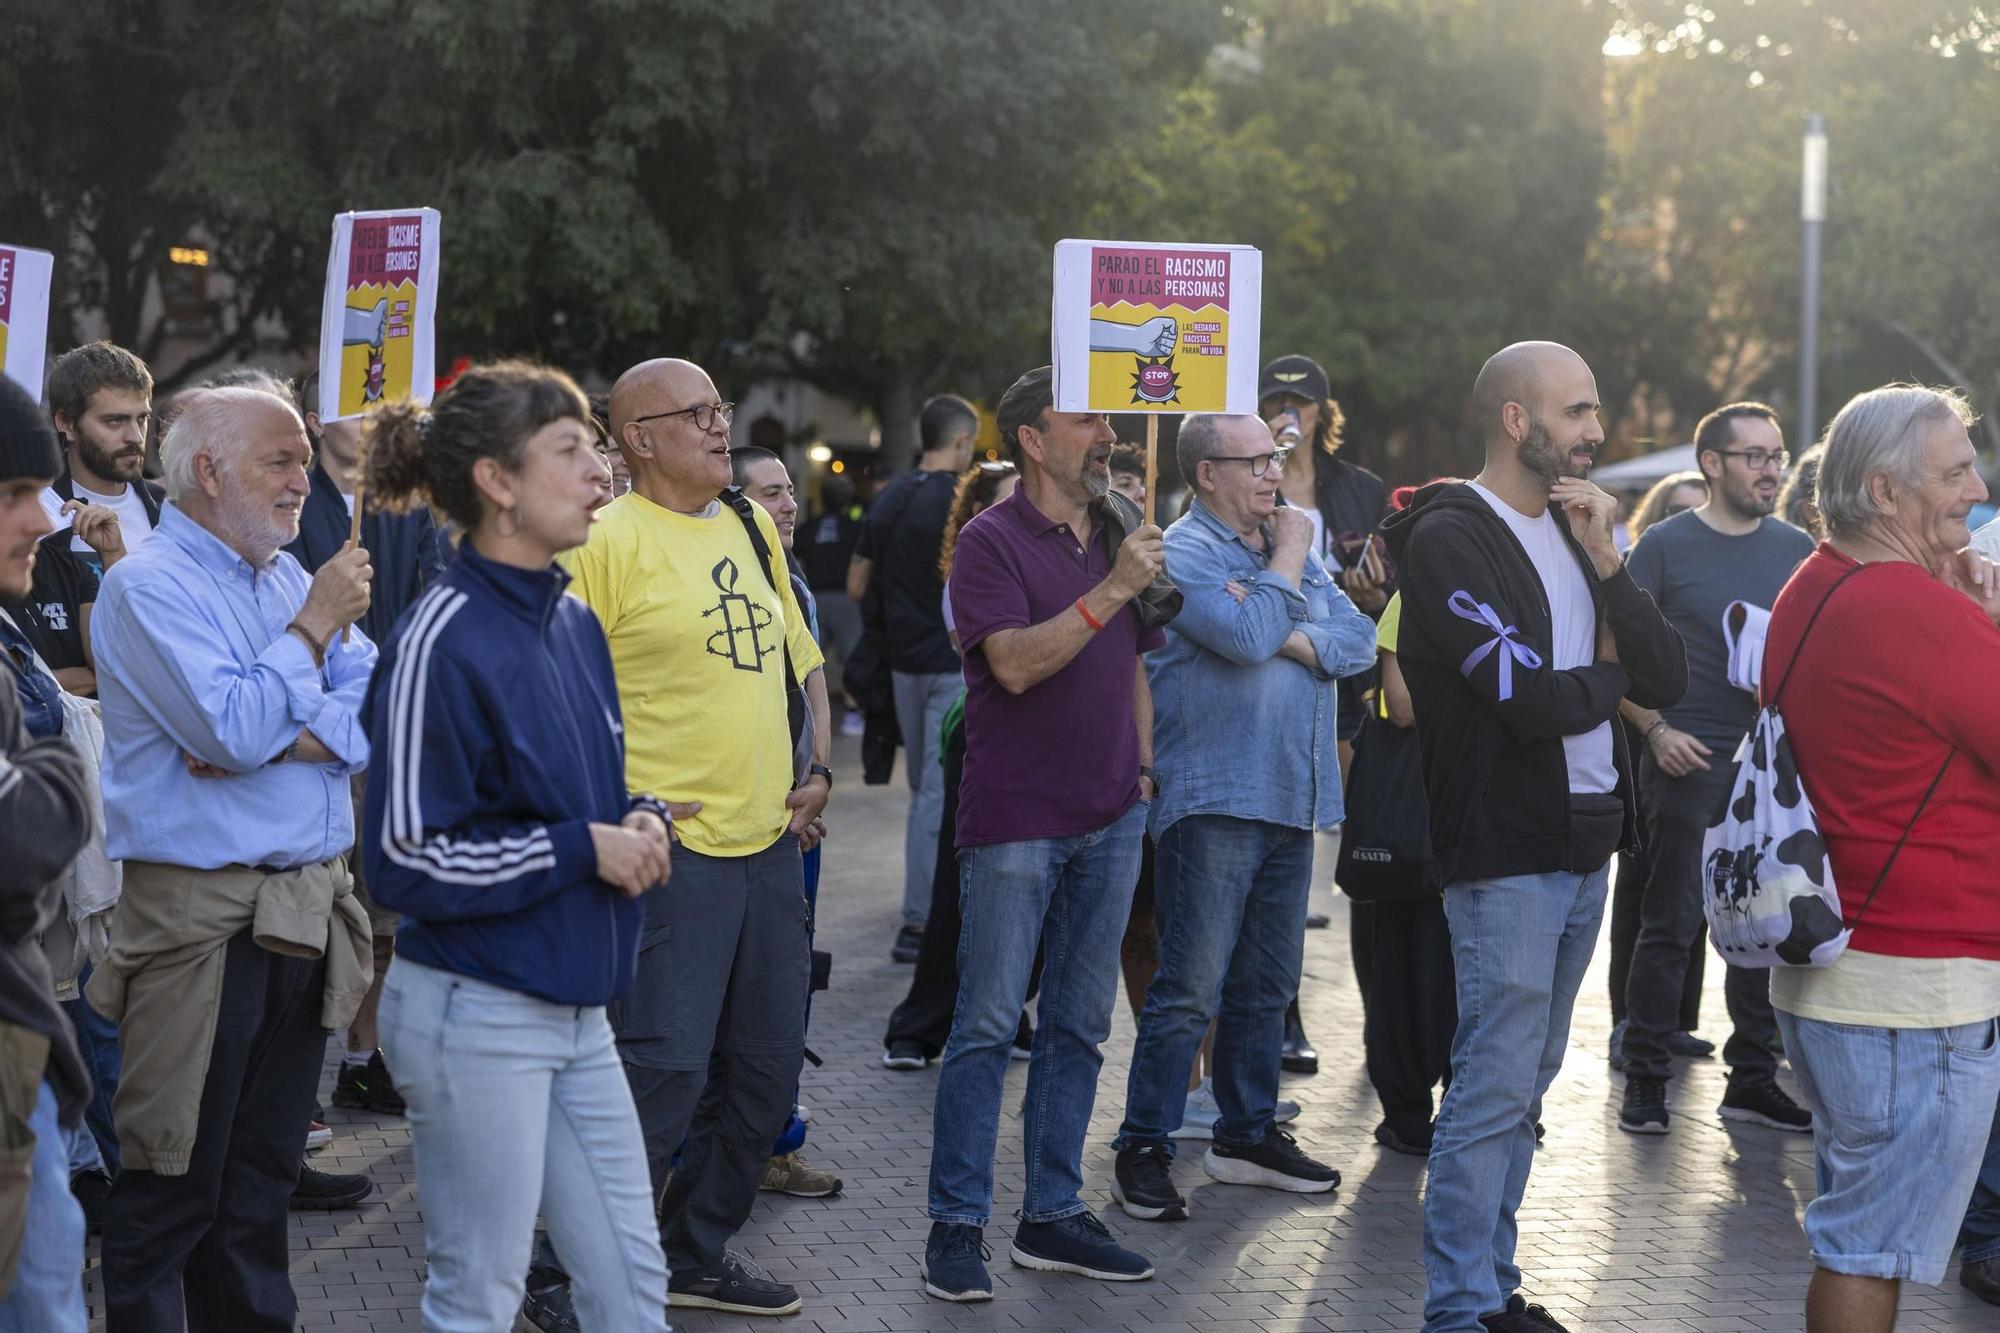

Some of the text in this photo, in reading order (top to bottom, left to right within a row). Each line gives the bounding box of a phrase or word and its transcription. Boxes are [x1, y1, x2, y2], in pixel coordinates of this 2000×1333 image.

[385, 251, 418, 272] PERSONES
[1098, 255, 1226, 277] PARAD EL RACISMO
[1097, 278, 1225, 297] Y NO A LAS PERSONAS
[1183, 323, 1219, 331] LAS REDADAS
[1183, 334, 1210, 343] RACISTAS
[1201, 347, 1208, 355] MI
